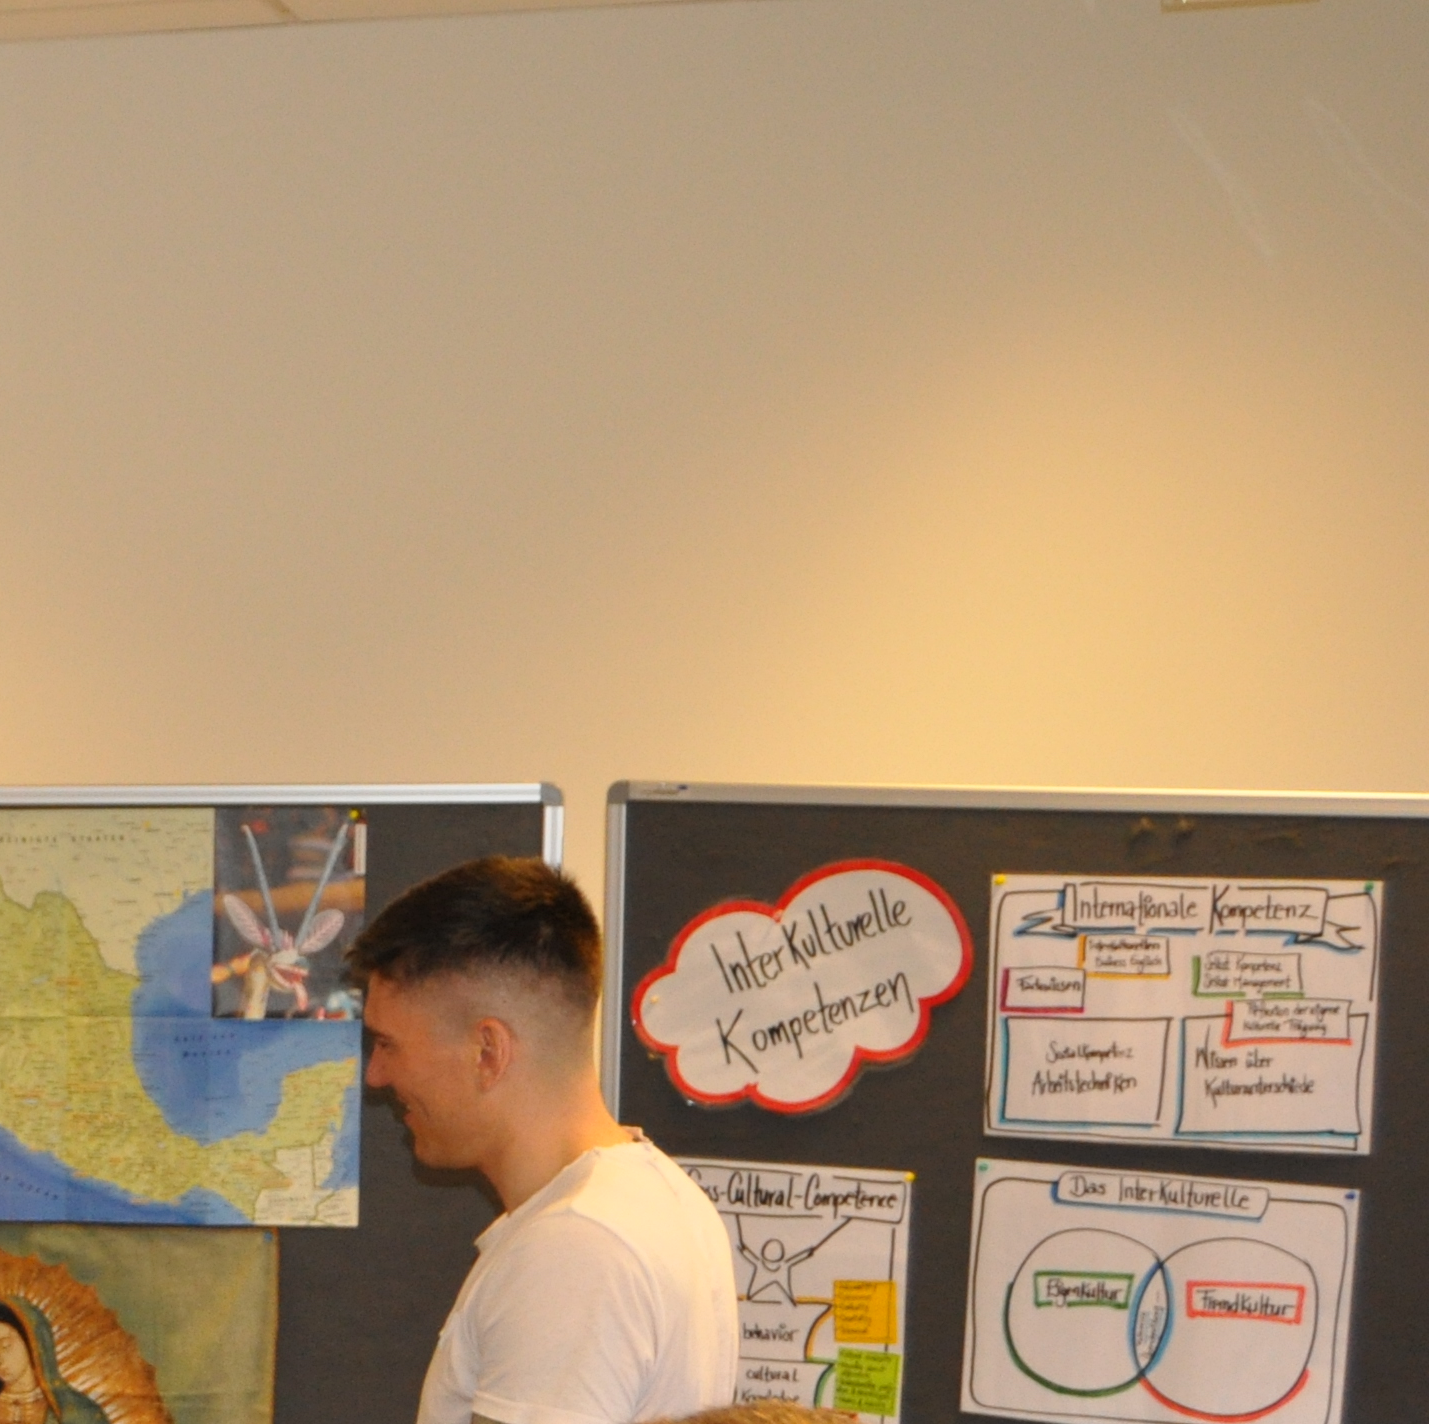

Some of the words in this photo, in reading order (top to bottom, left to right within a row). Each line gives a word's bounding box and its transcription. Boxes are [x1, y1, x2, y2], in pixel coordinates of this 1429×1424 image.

[1209, 884, 1319, 935] Kompetenz
[715, 972, 915, 1075] Kompetenzen
[1069, 1174, 1107, 1198] Das
